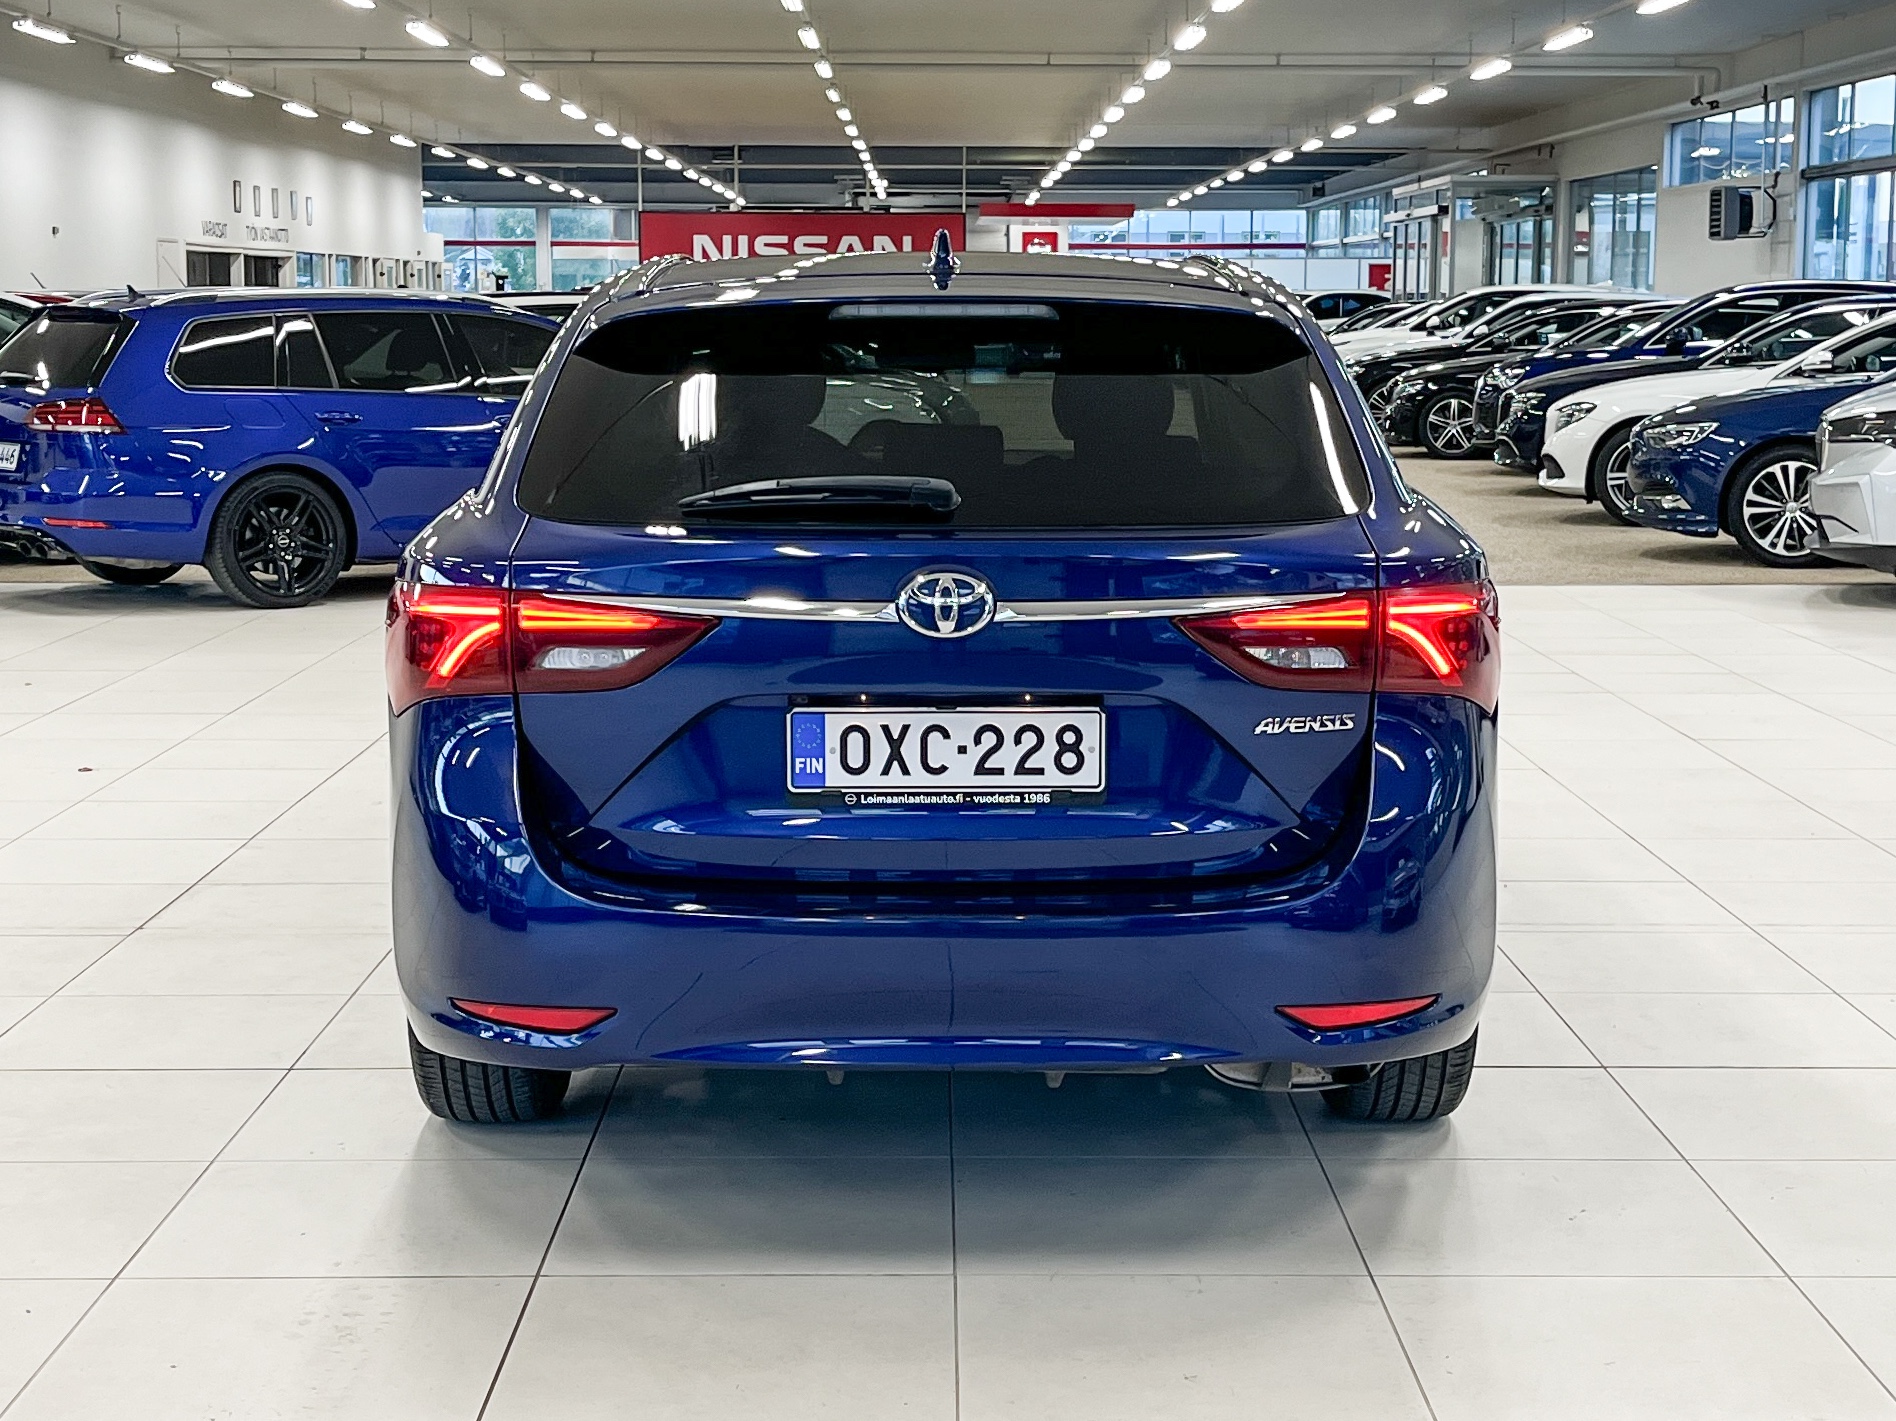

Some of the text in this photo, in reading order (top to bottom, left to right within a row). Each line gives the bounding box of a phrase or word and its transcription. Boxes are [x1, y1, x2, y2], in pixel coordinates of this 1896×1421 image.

[1254, 713, 1355, 735] AVENSIS
[839, 723, 1085, 776] OXC-228
[795, 757, 823, 774] FIN
[860, 793, 964, 804] Loimaanlaatuauto.fi
[973, 794, 1021, 804] vuodesta
[1023, 793, 1051, 804] 1986
